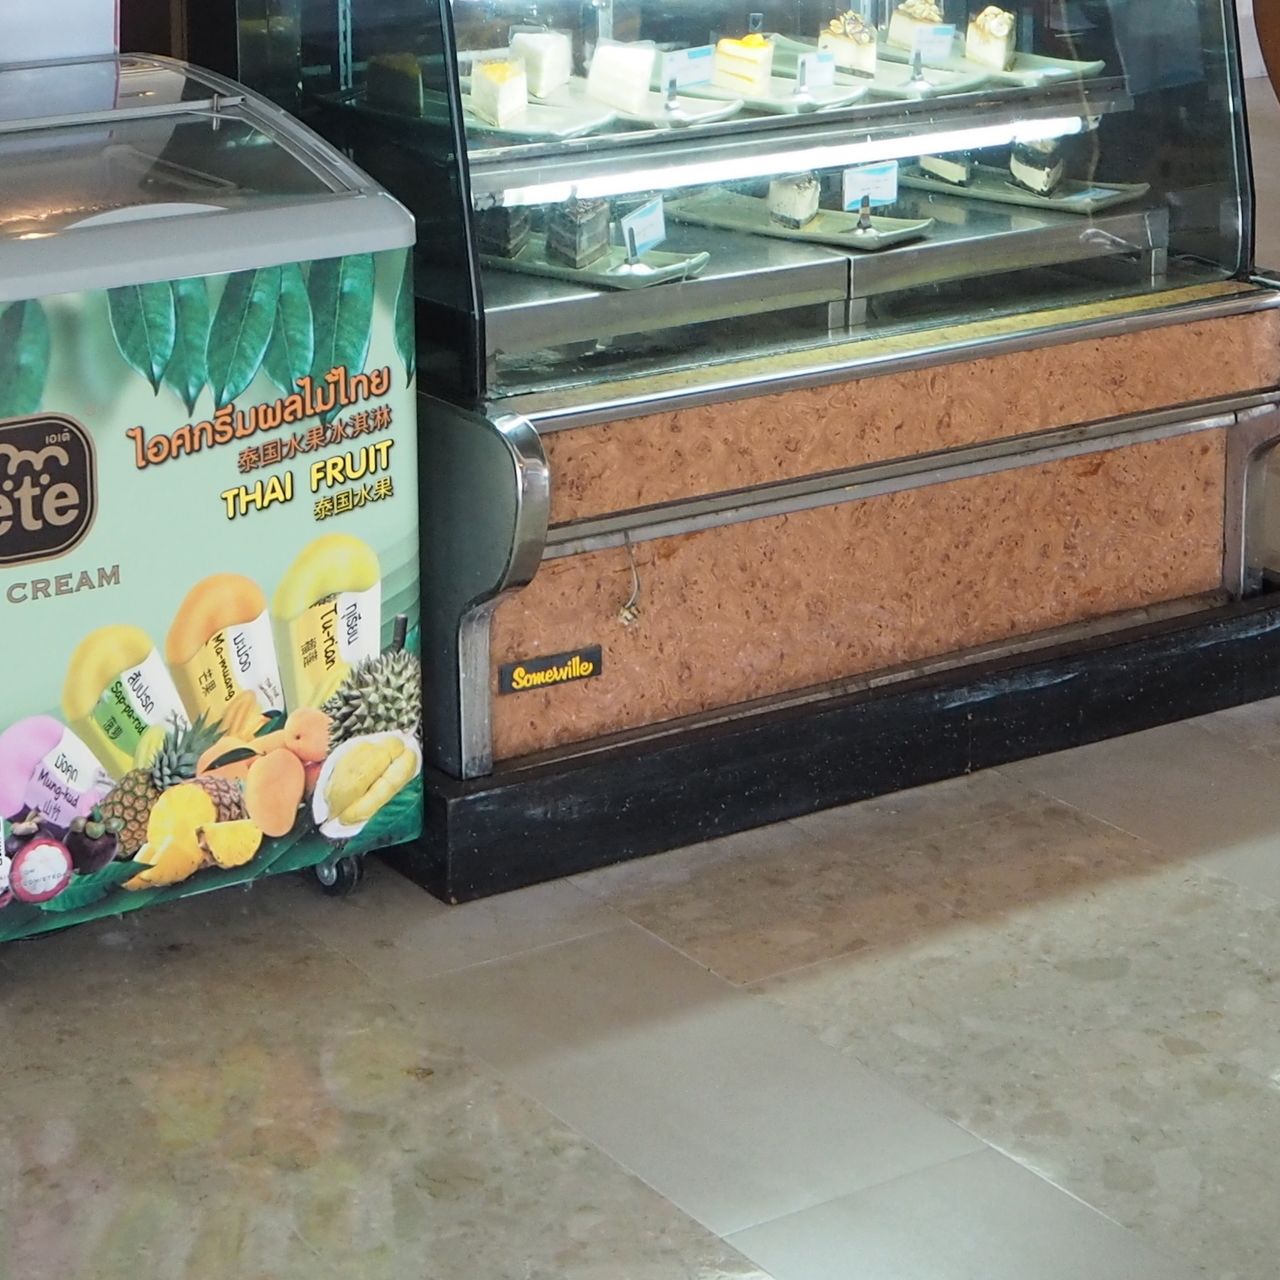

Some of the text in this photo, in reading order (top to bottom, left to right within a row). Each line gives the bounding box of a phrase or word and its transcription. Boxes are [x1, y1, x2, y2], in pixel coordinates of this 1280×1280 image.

[125, 364, 391, 470] ไอศกรีมผลไม้ไทย
[237, 403, 393, 474] 泰国水果冰淇淋
[220, 438, 395, 520] THAI FRUIT
[313, 475, 395, 522] 泰国水果
[6, 564, 121, 605] CREAM
[319, 600, 339, 671] Tu-rian
[197, 668, 217, 698] 芒果
[211, 632, 235, 703] Ma-muang
[511, 655, 594, 690] Somerville
[110, 679, 148, 737] Sap-pa-rod
[37, 767, 81, 809] Mung-kud
